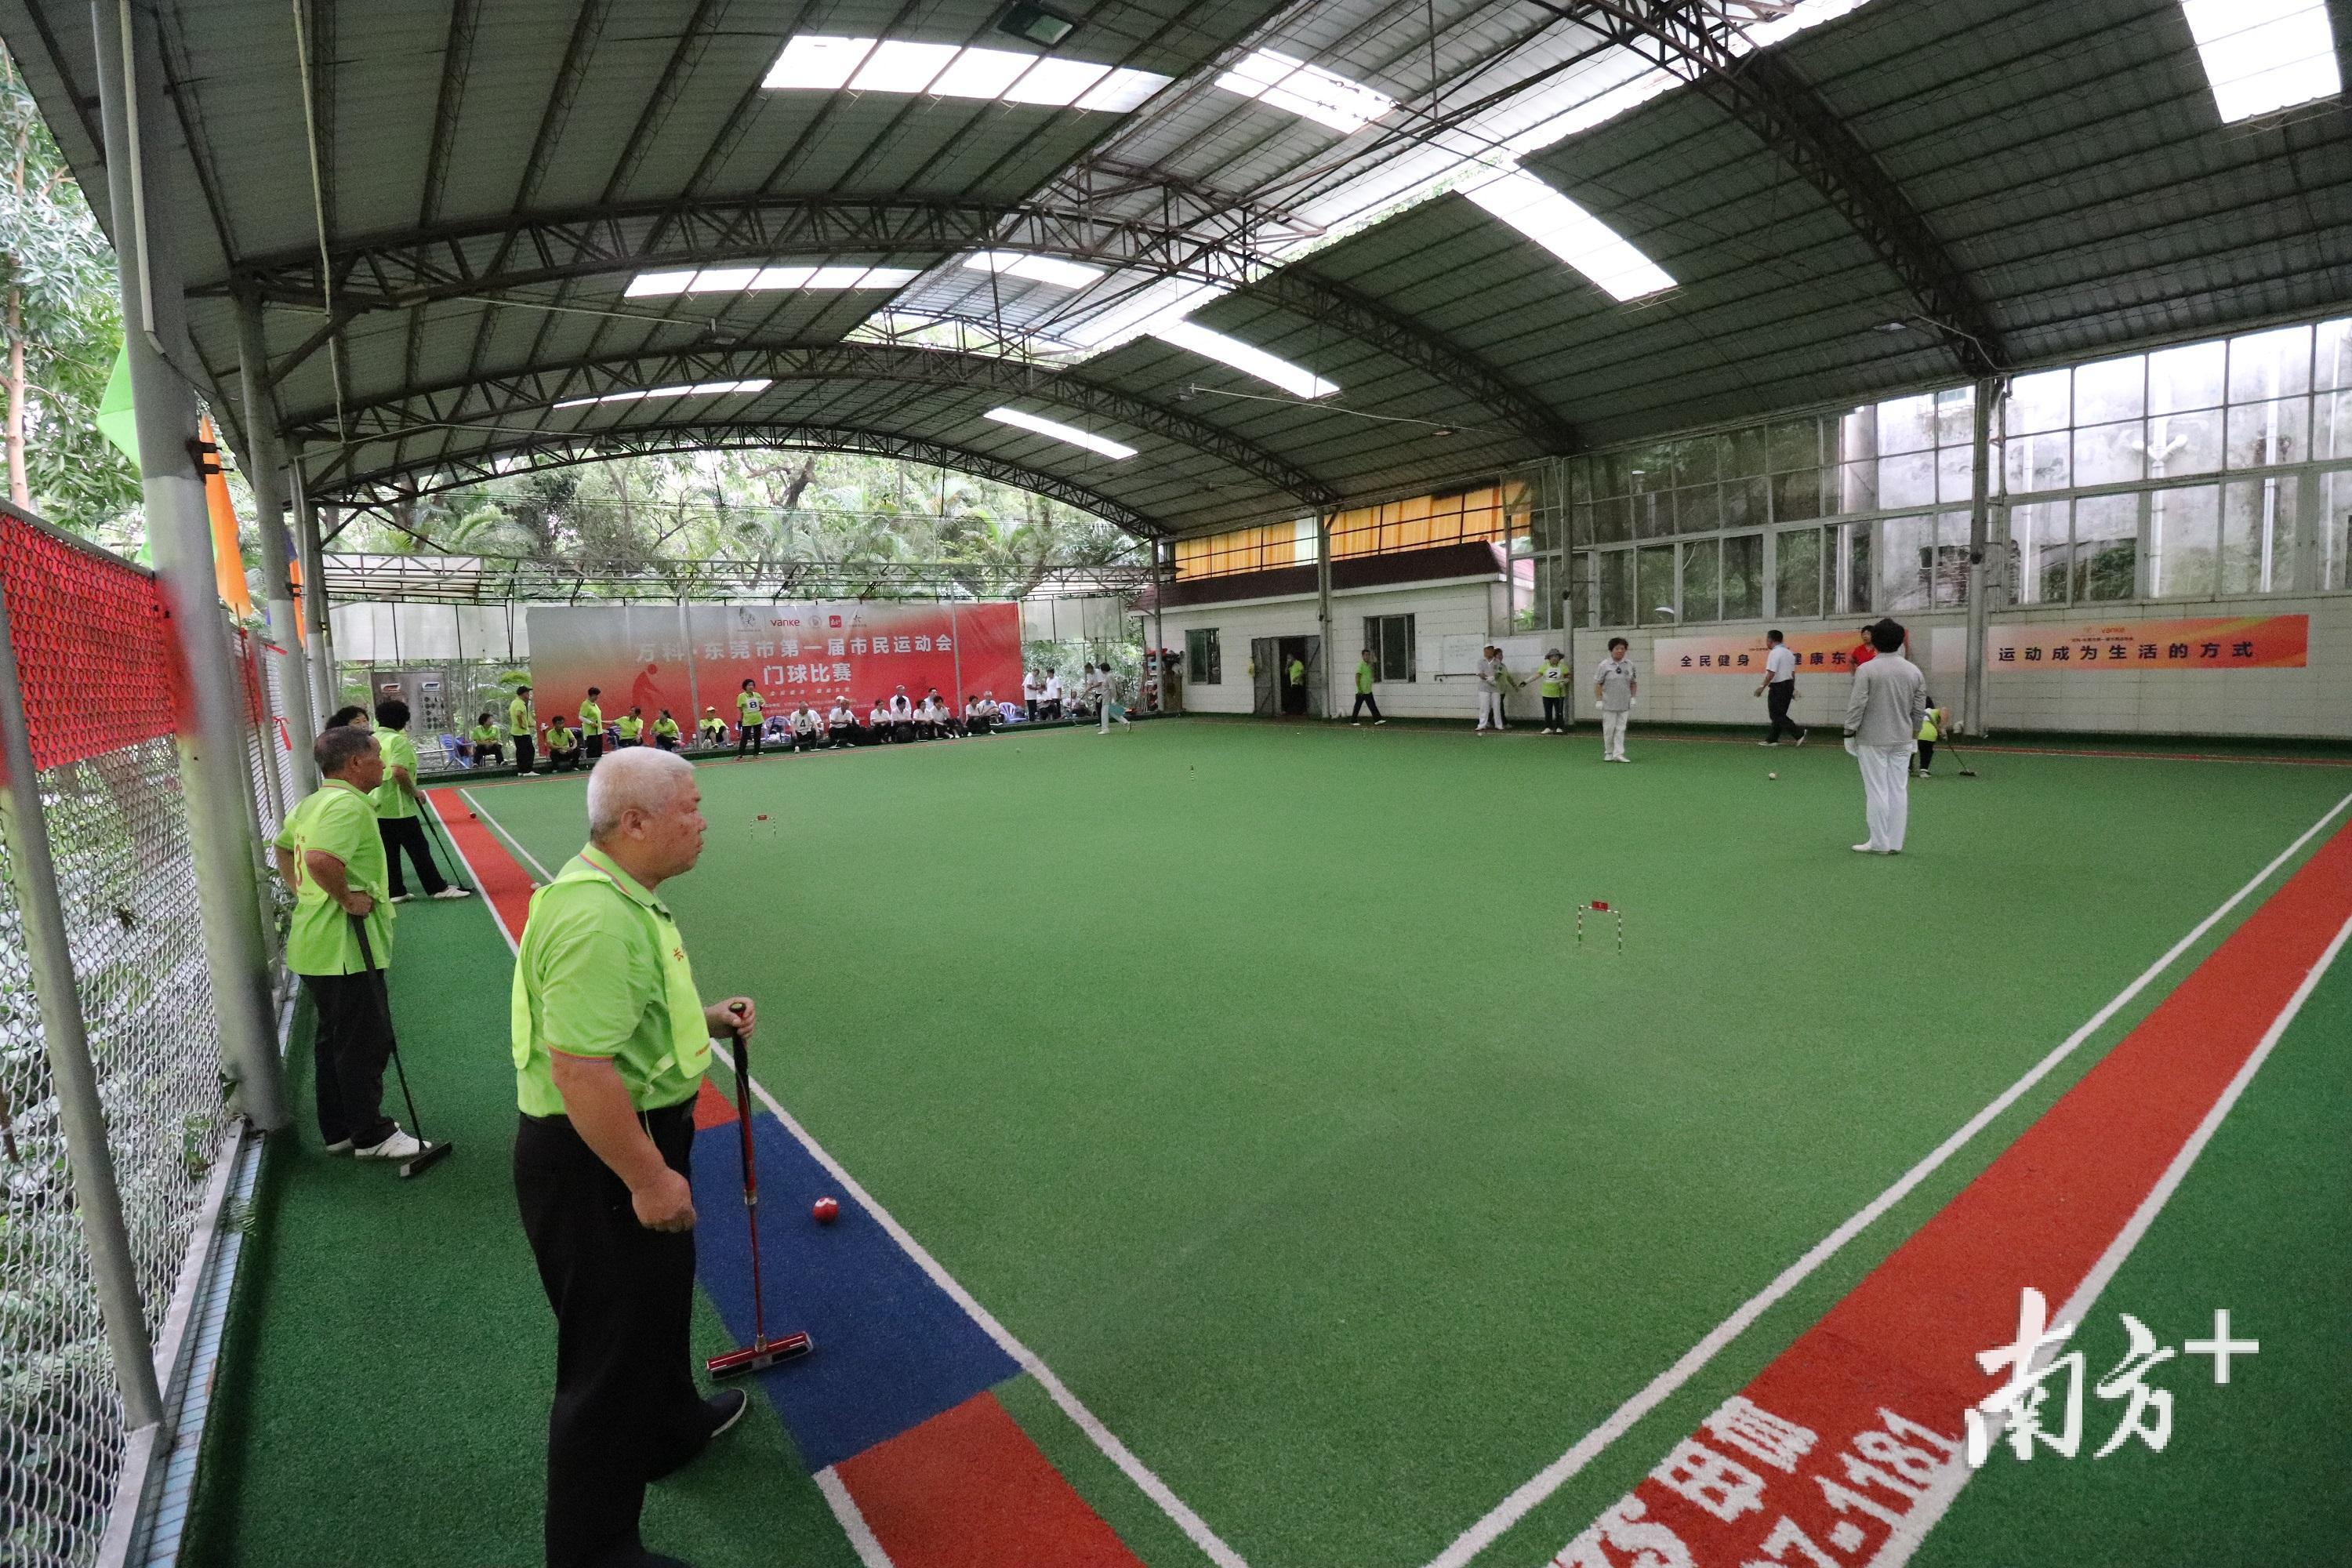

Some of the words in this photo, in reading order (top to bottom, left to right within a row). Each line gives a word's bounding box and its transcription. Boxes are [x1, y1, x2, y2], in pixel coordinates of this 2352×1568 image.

[1998, 641, 2254, 662] 运动成为生活的方式
[1680, 654, 1750, 667] 全民健身
[764, 662, 851, 685] 门球比赛
[800, 719, 806, 728] 4
